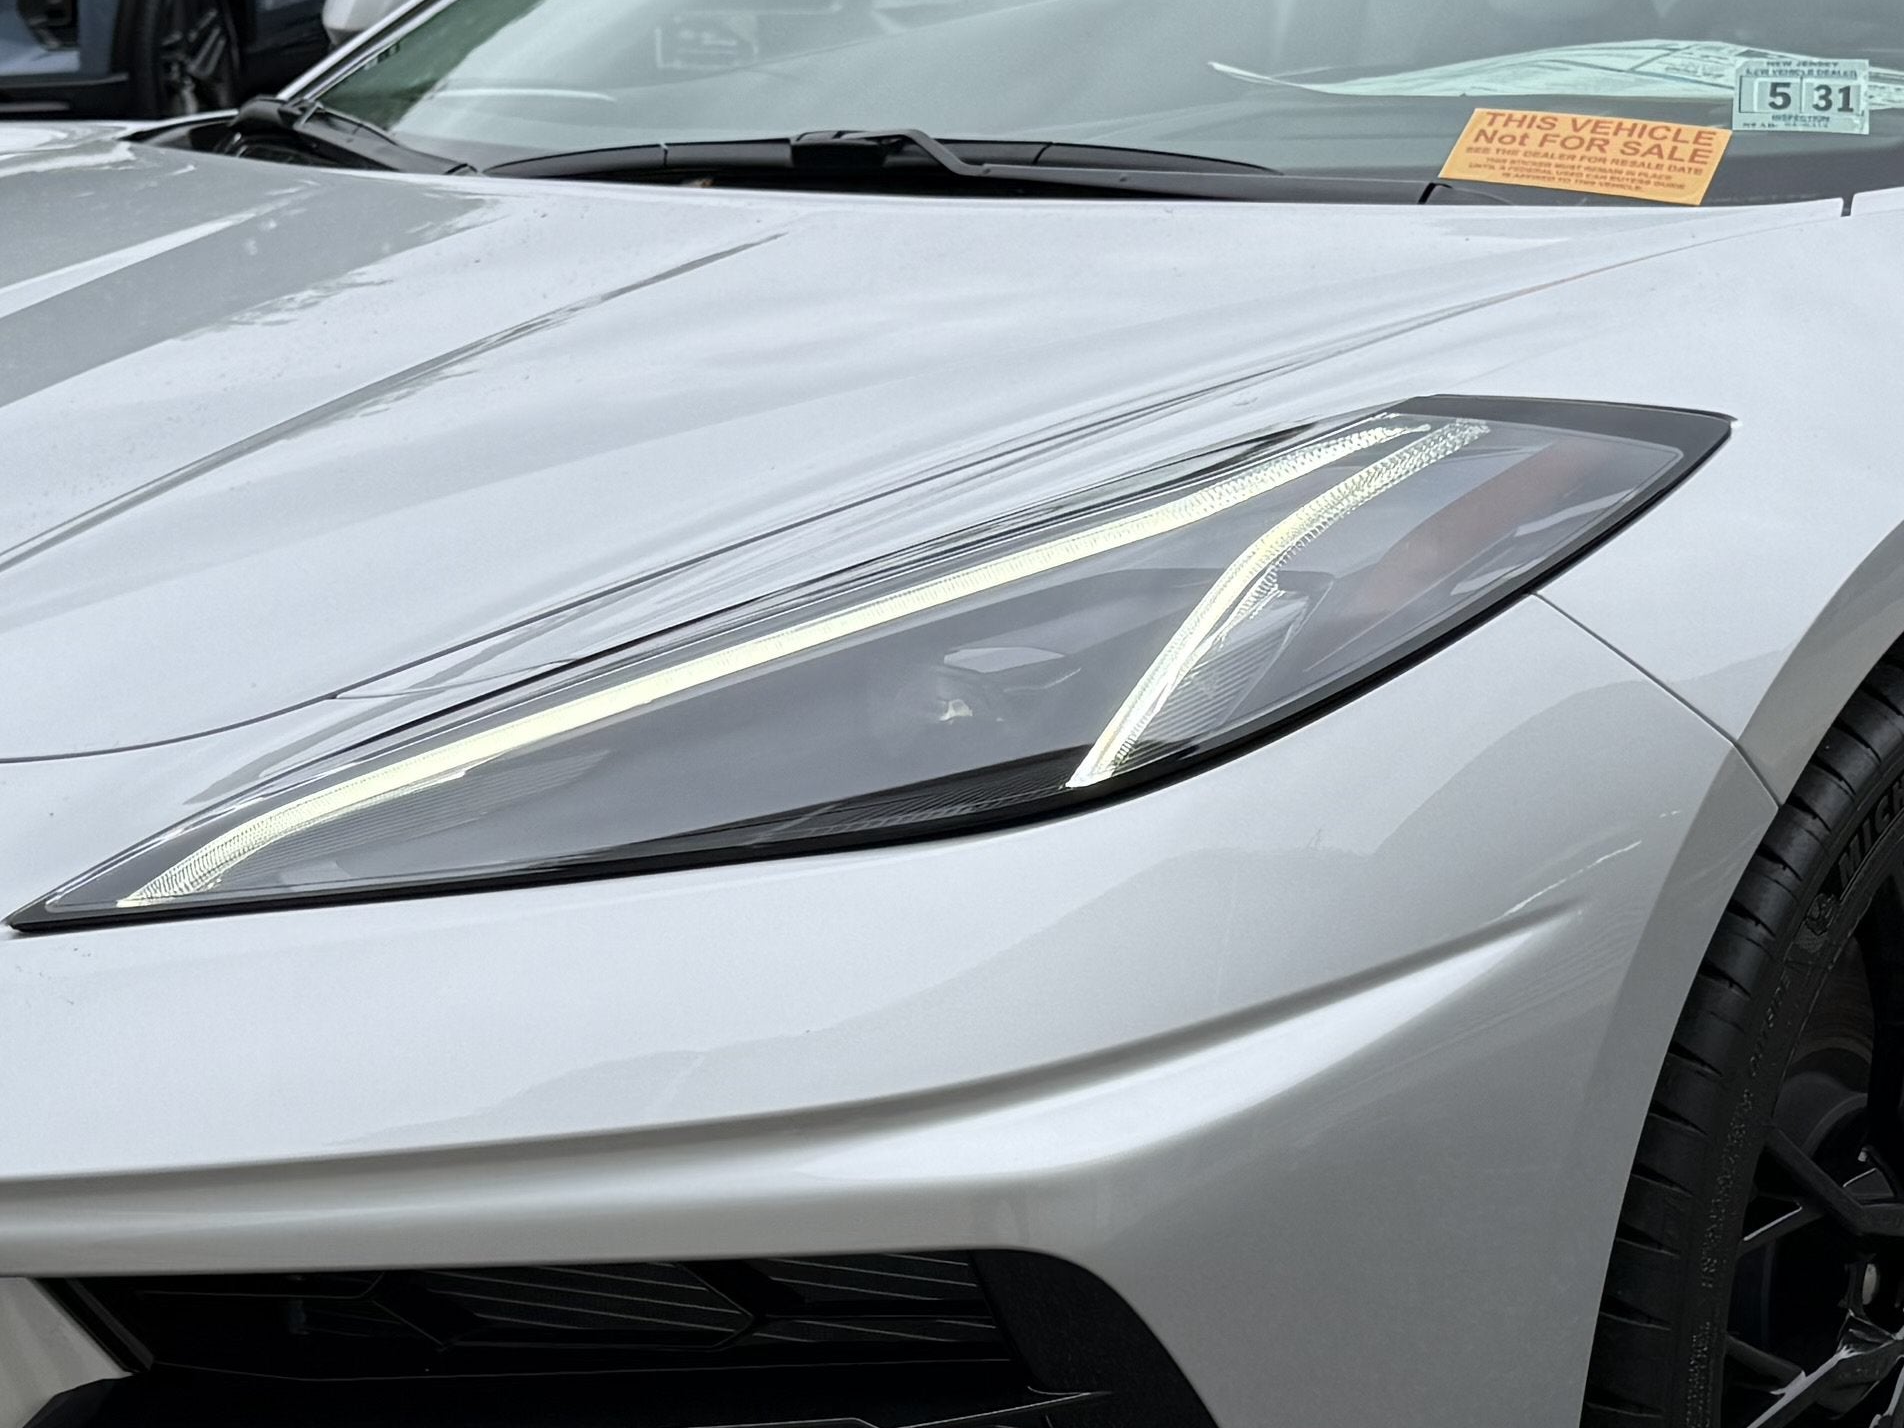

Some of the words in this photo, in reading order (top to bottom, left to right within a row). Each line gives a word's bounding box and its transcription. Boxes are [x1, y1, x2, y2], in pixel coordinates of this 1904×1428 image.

[1768, 82, 1791, 110] 5
[1812, 84, 1854, 112] 31
[1485, 111, 1559, 131] THIS
[1572, 117, 1717, 147] VEHICLE
[1473, 129, 1530, 147] Not
[1539, 133, 1610, 153] FOR
[1620, 140, 1713, 165] SALE
[1496, 148, 1520, 156] THE
[1523, 151, 1577, 162] DEALER
[1580, 155, 1607, 164] FOR
[1610, 158, 1665, 171] RESALE
[1668, 164, 1704, 176] DATE
